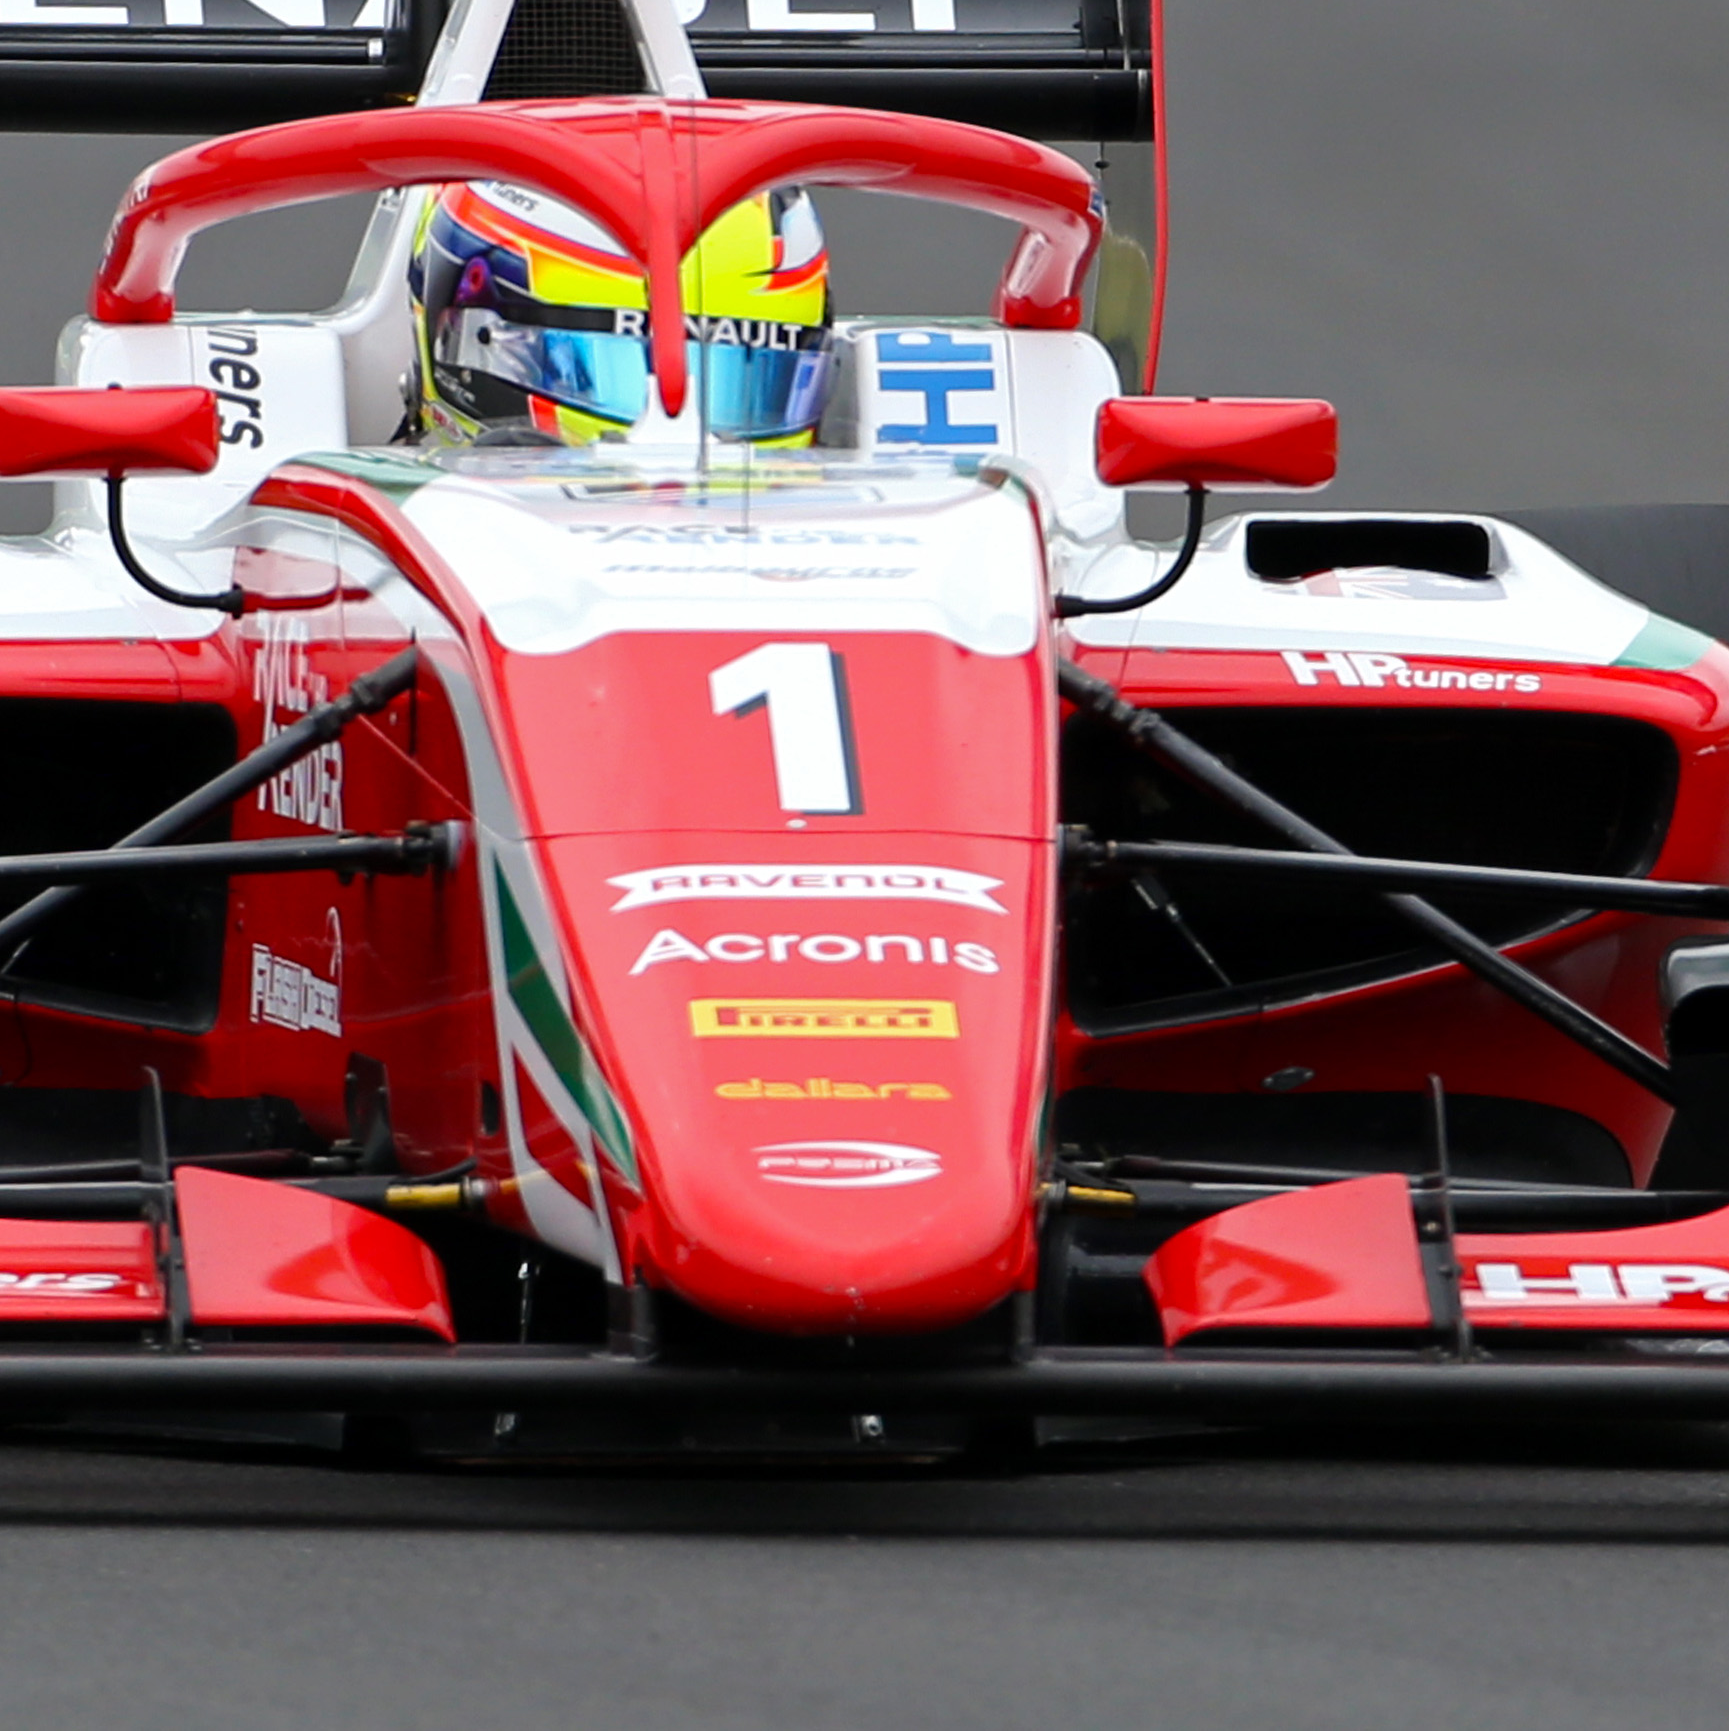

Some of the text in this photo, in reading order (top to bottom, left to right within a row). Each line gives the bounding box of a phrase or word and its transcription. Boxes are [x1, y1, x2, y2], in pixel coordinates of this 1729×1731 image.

[615, 309, 803, 351] RNAULT
[708, 642, 865, 815] 1
[649, 872, 970, 896] RAVENOL
[627, 929, 1000, 975] Acronis
[714, 1005, 932, 1029] PIRELLI
[714, 1076, 953, 1102] dallara
